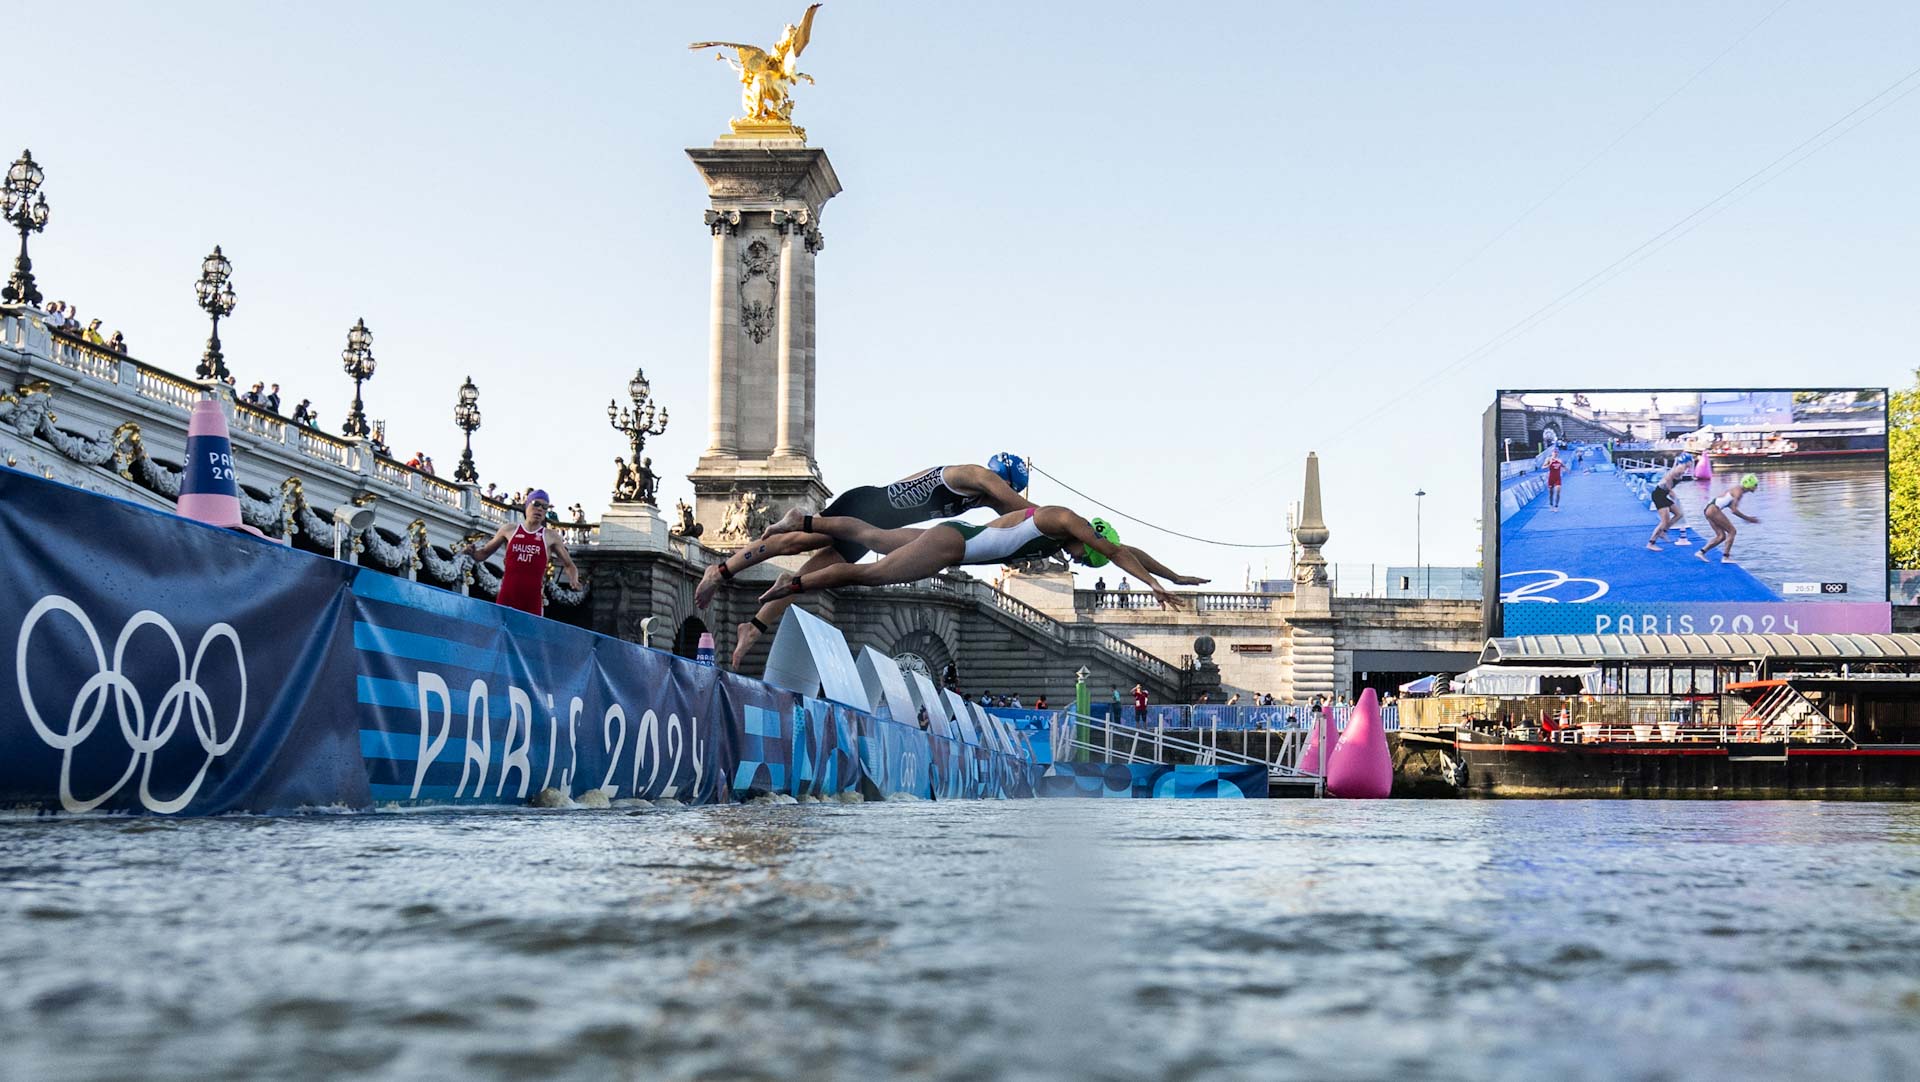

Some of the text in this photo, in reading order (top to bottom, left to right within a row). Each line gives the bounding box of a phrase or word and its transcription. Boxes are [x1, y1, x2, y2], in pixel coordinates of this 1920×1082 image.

[512, 543, 541, 555] HAUSER
[517, 553, 533, 563] AUT
[1709, 615, 1799, 635] 2024
[601, 703, 704, 798] 2024
